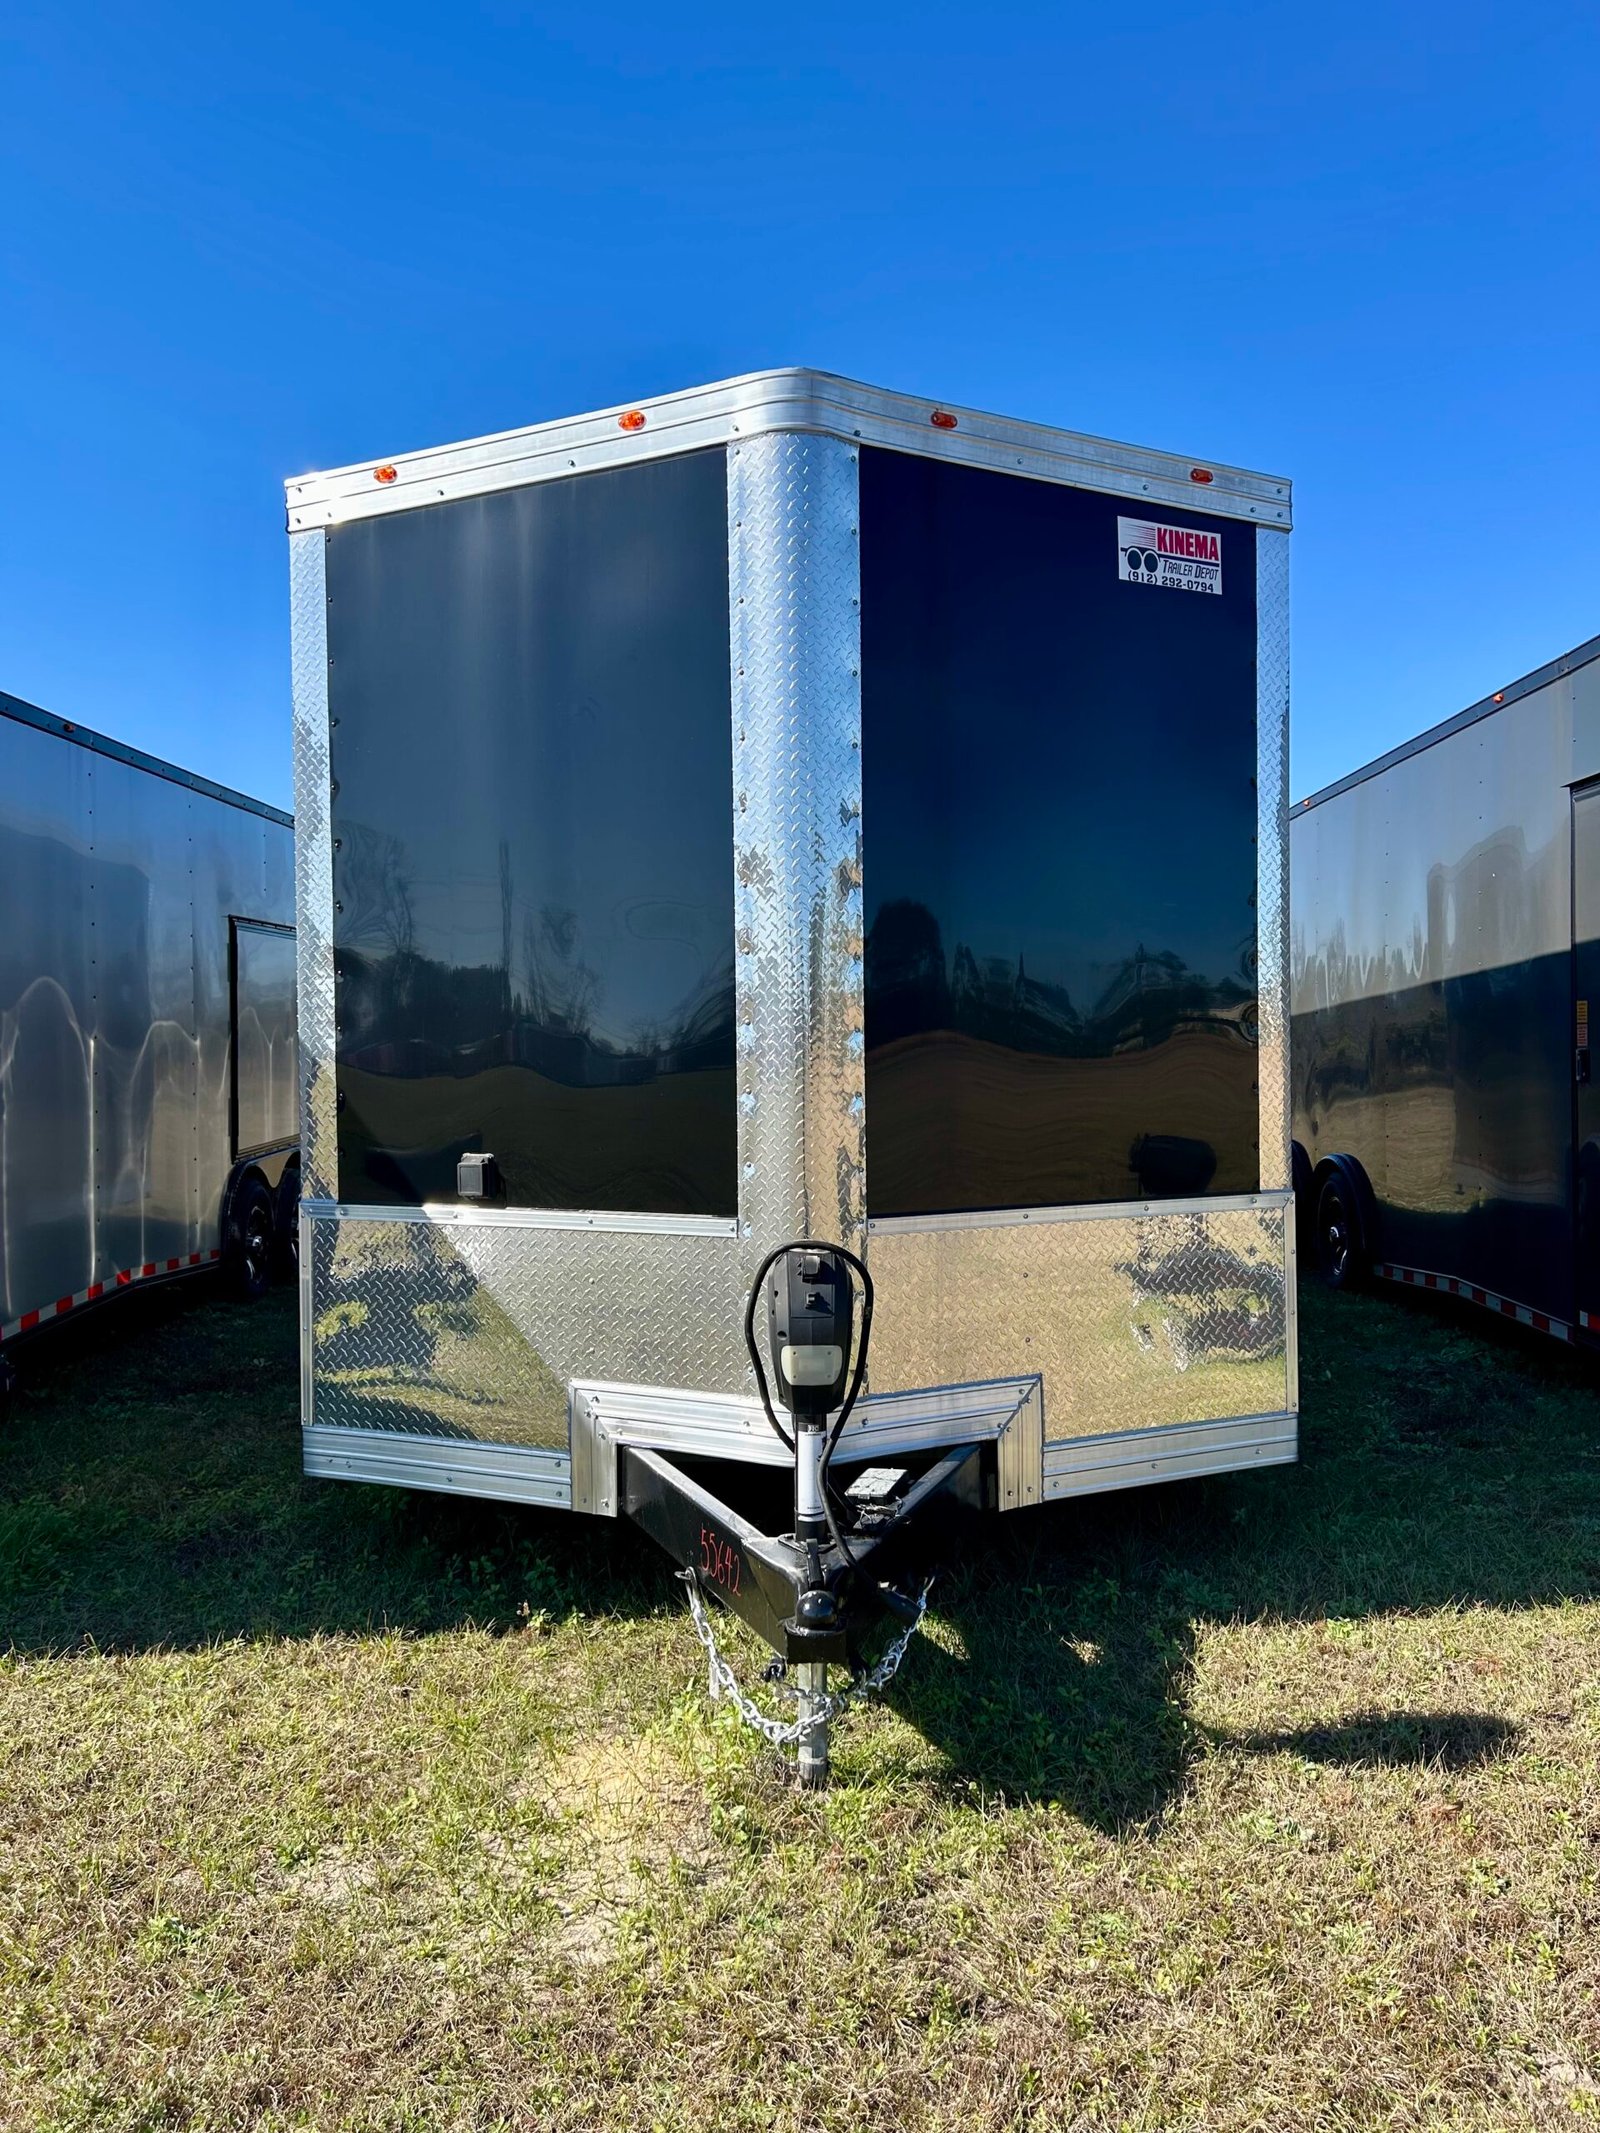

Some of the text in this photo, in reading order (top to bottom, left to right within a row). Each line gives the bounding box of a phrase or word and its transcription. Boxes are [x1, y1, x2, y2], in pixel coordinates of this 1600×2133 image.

[1157, 527, 1219, 561] KINEMA
[1128, 570, 1214, 592] (912) 292-0794
[700, 1527, 741, 1596] 55642
